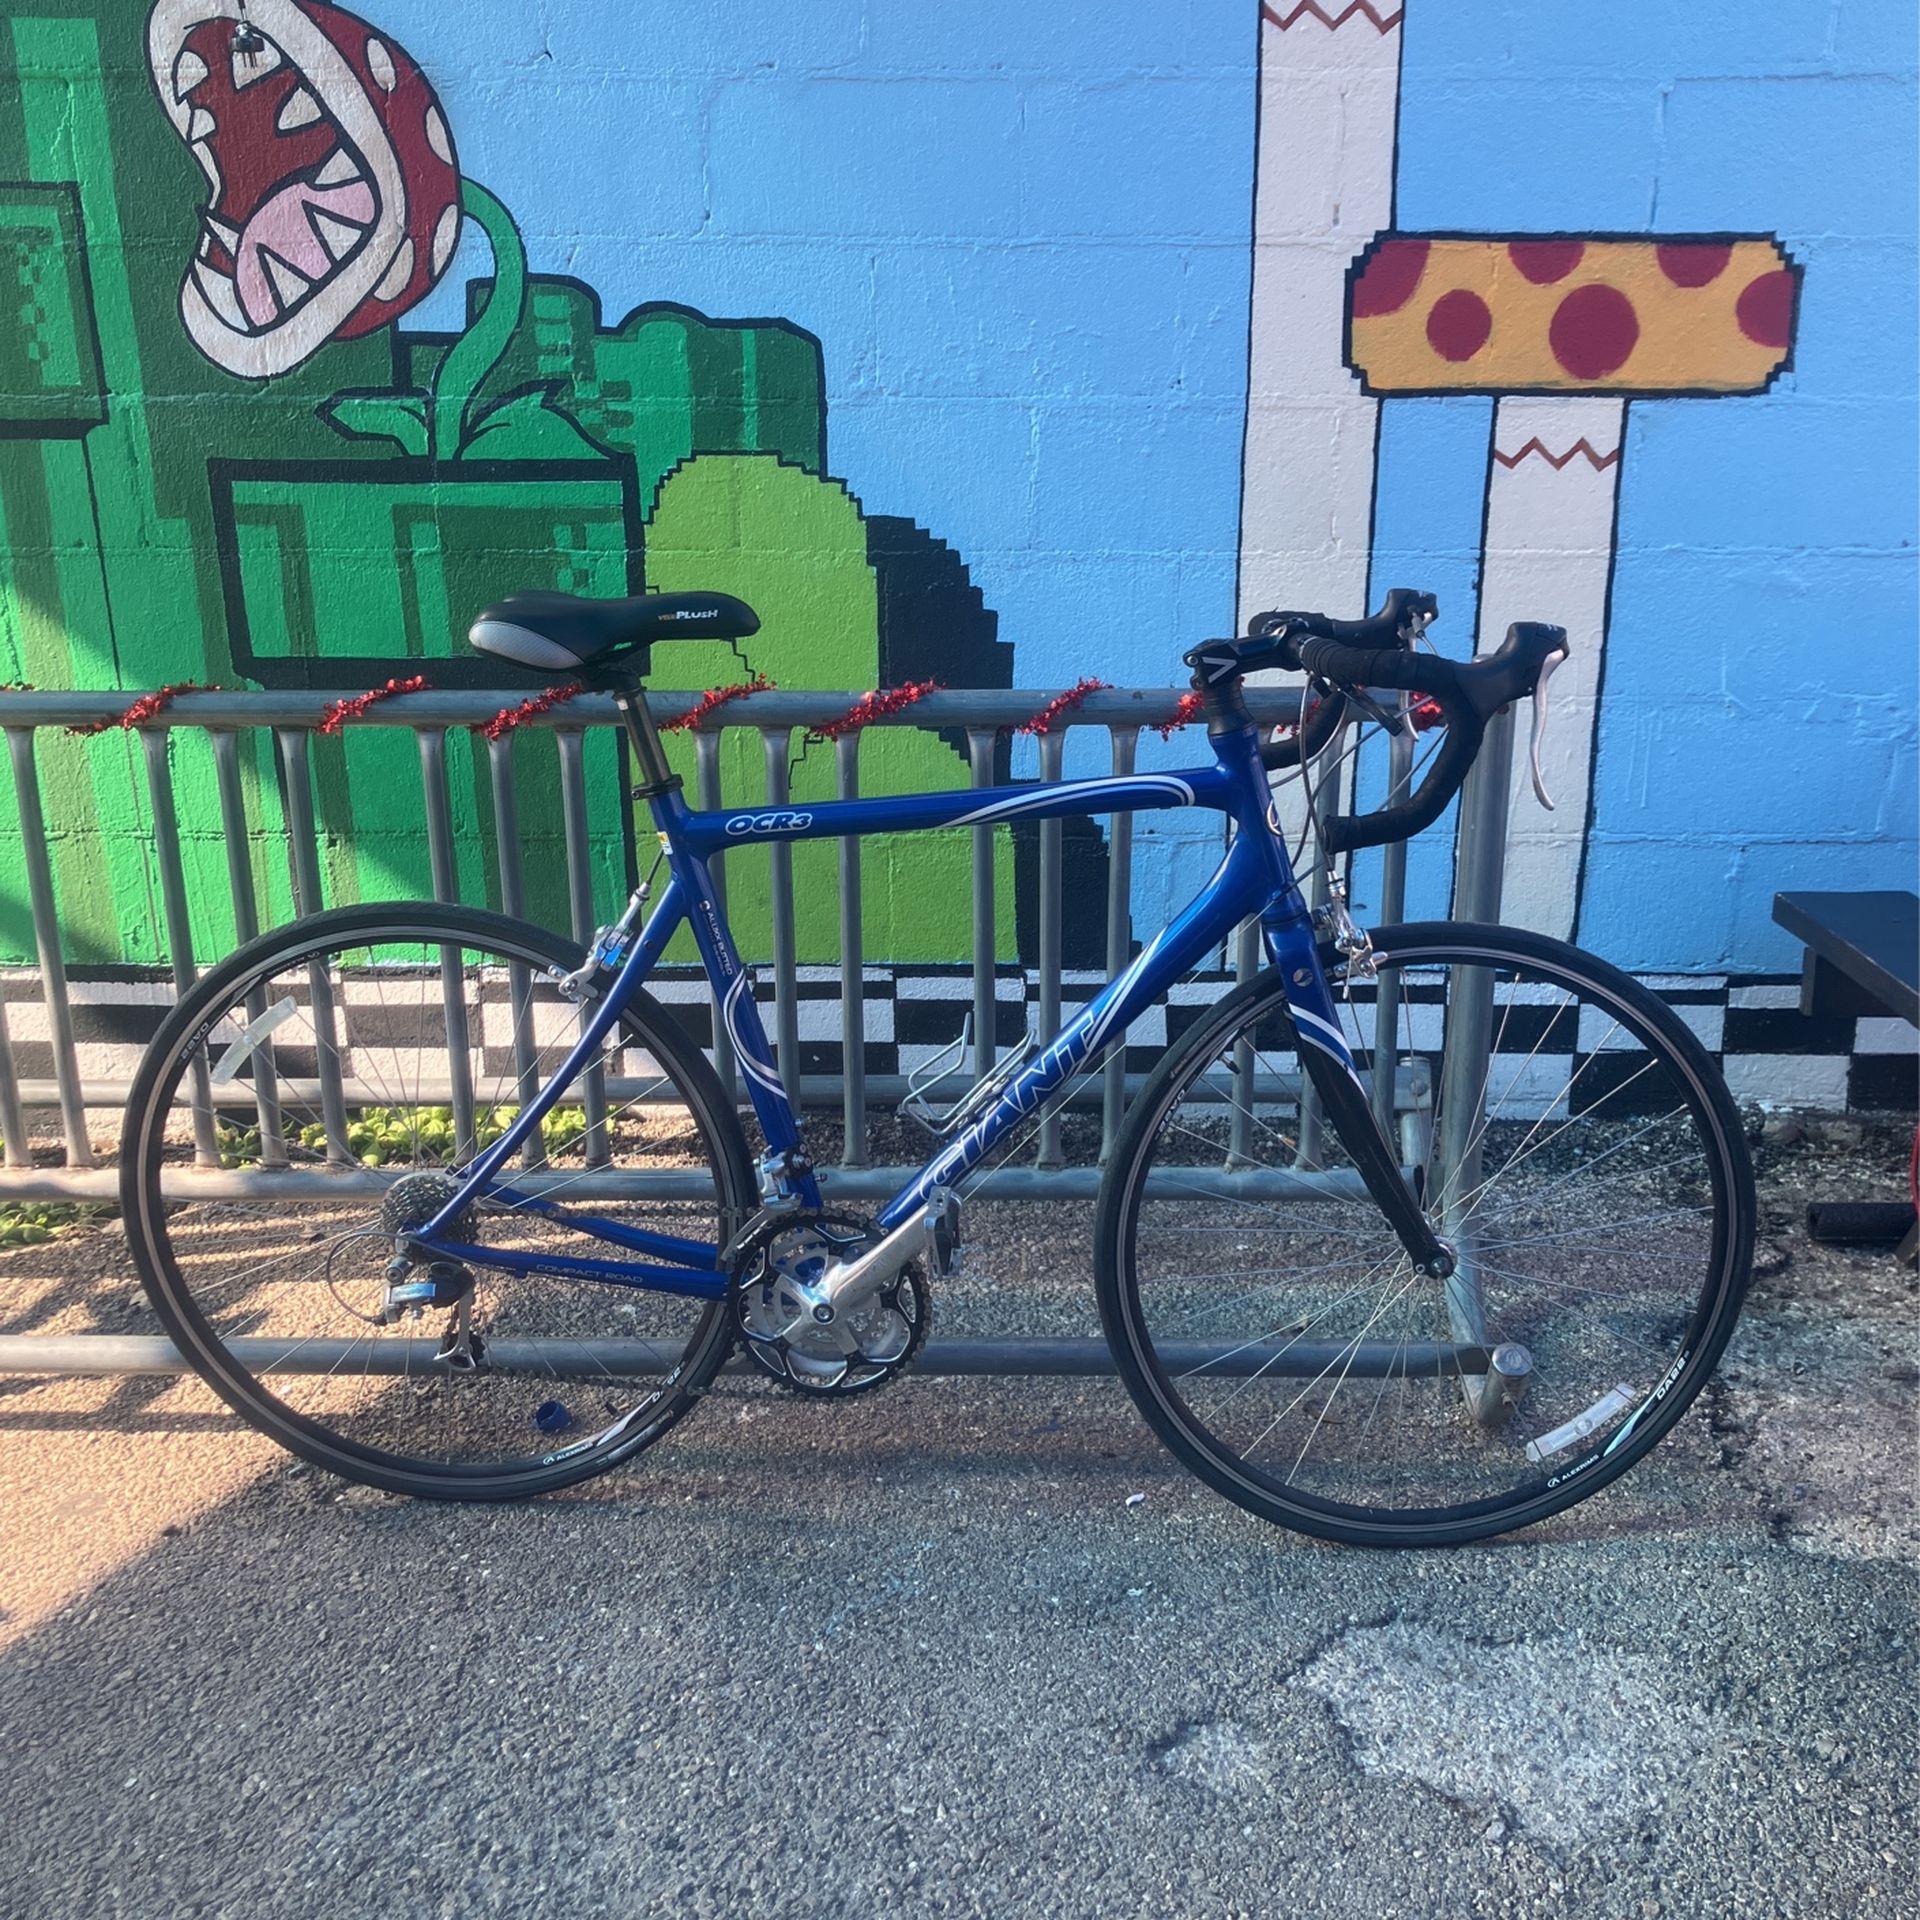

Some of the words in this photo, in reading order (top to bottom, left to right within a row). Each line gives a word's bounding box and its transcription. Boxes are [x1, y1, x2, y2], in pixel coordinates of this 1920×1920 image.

[676, 609, 719, 620] PLUSH
[725, 812, 813, 836] OCR3
[919, 1009, 1095, 1201] GIANT
[536, 1263, 602, 1279] COMPACT
[604, 1272, 644, 1284] ROAD
[1562, 1455, 1599, 1480] ALEXRIMS
